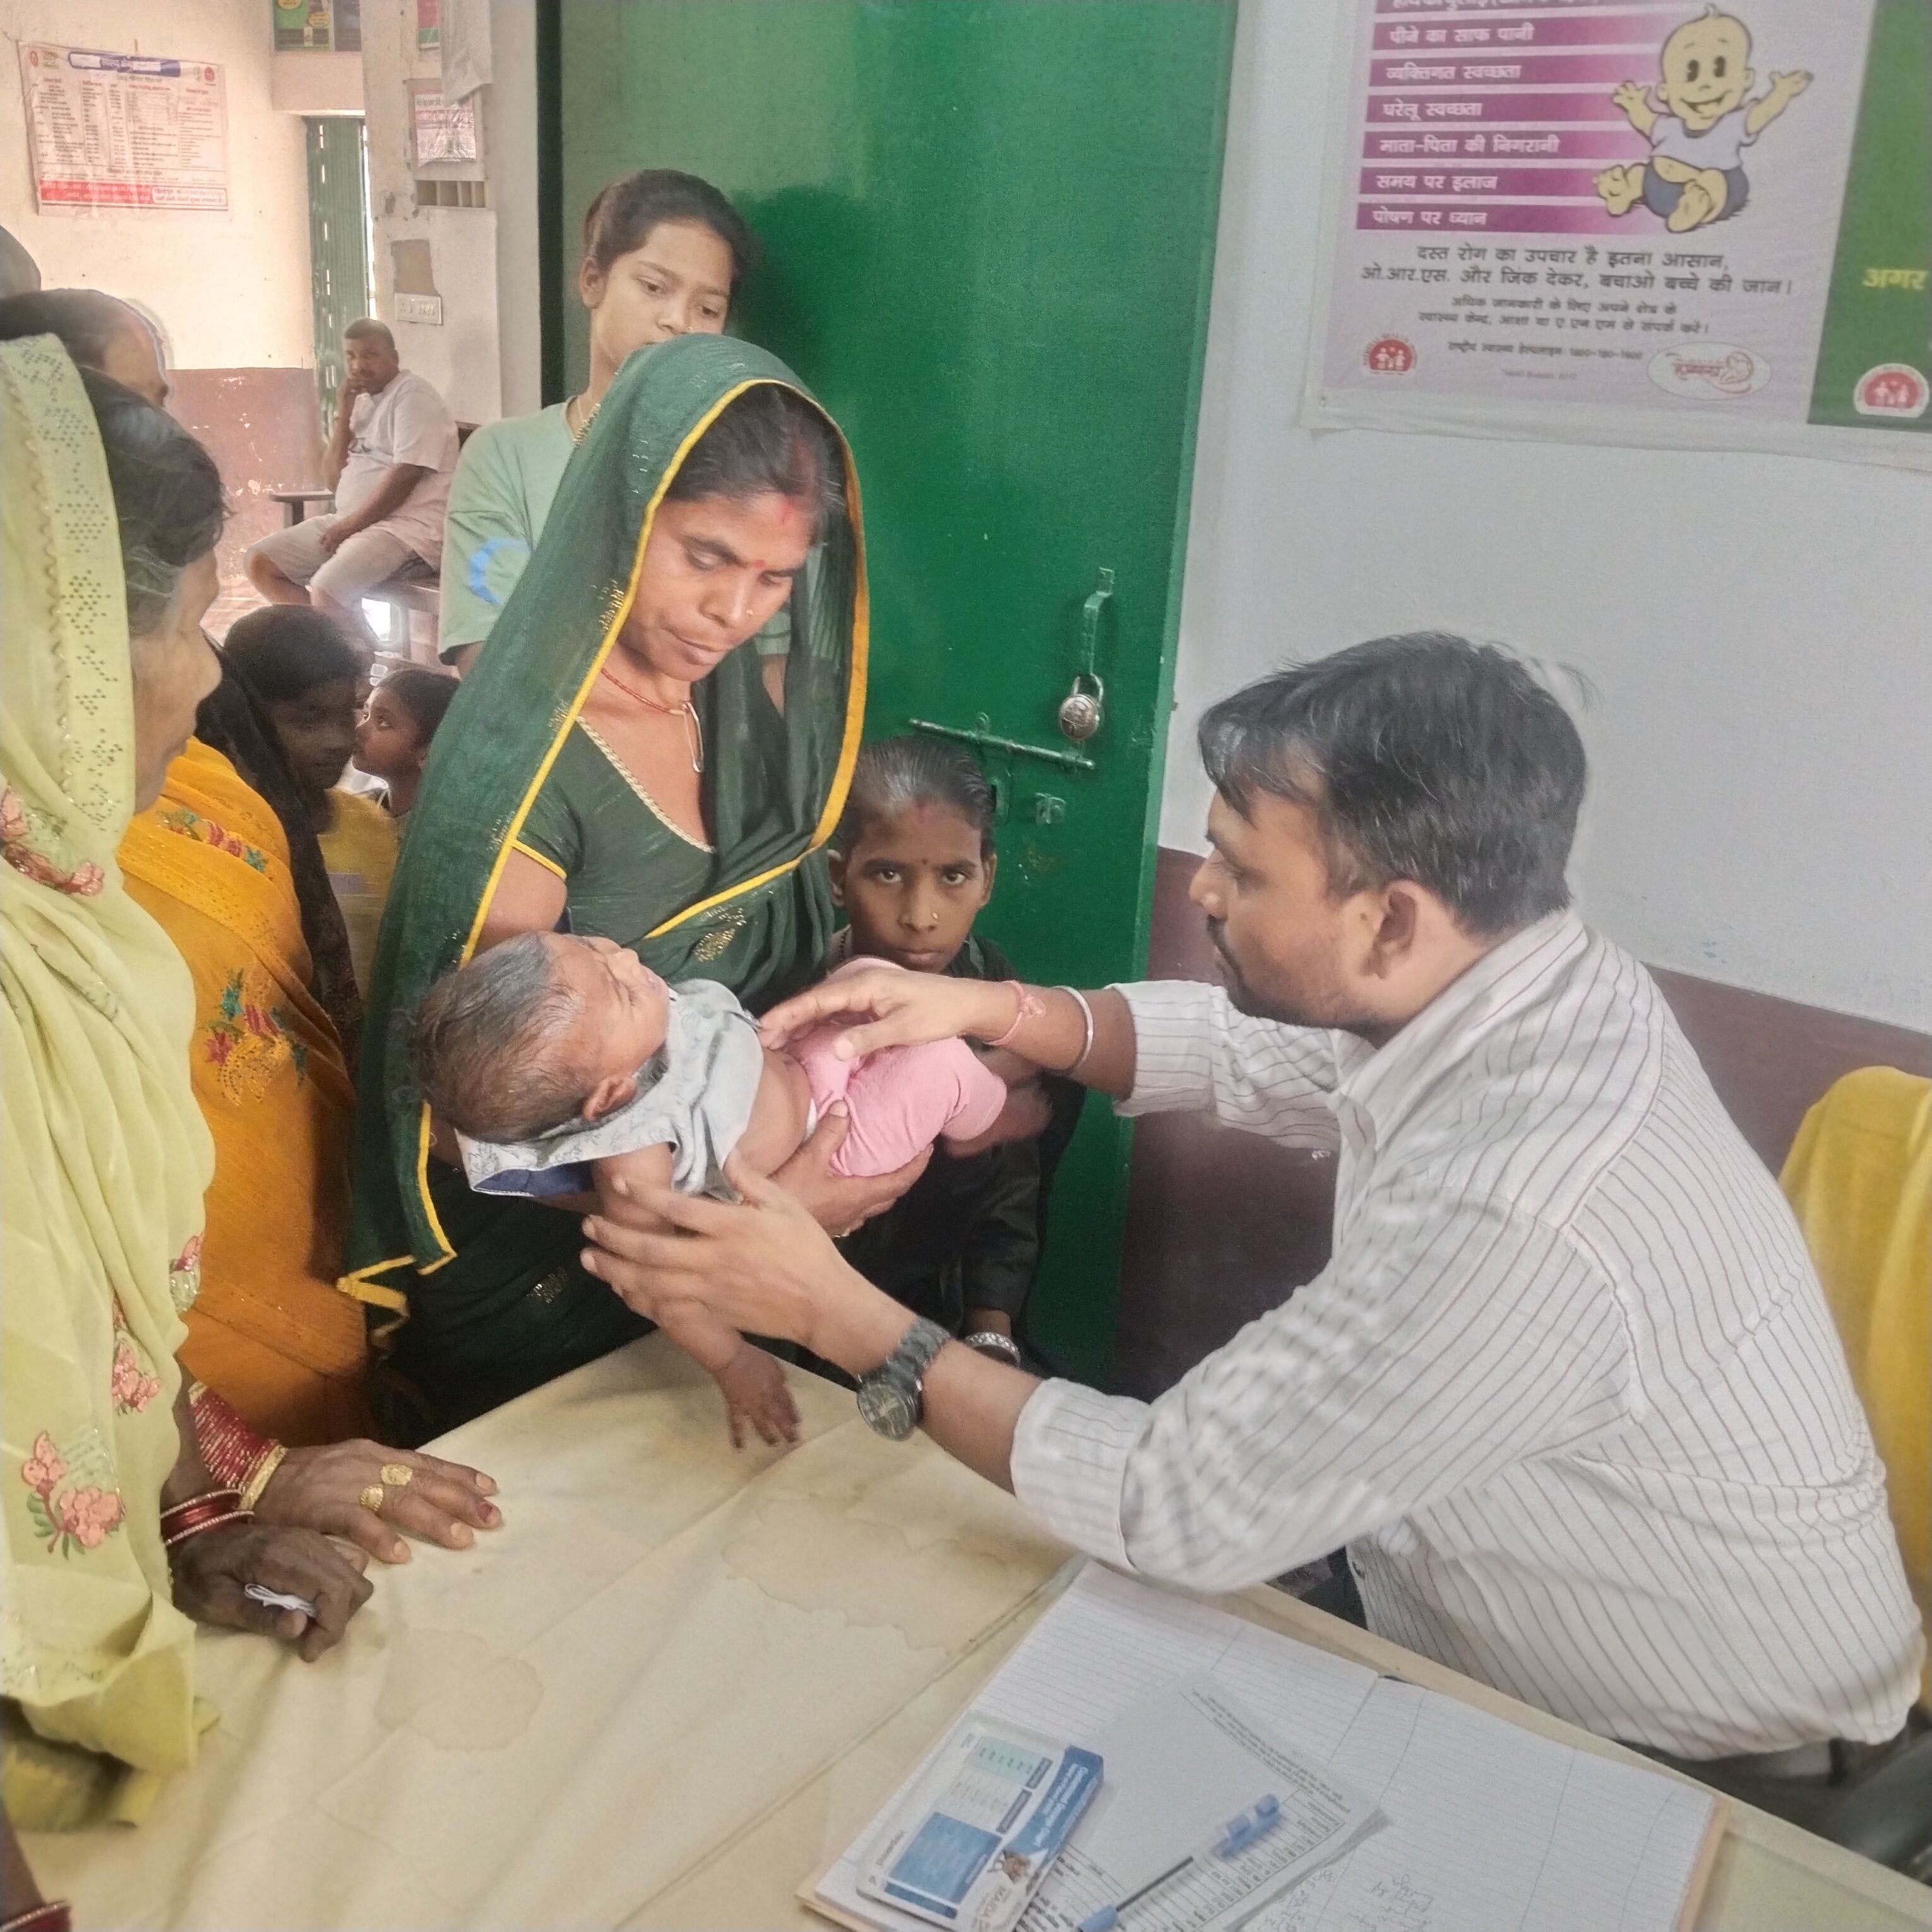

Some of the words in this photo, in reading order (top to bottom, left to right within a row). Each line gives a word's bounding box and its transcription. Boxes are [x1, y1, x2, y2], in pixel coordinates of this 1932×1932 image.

[1390, 25, 1419, 44] पीने
[1426, 28, 1446, 43] का
[1455, 27, 1490, 43] साफ
[1498, 22, 1534, 42] पानी
[1386, 62, 1455, 82] व्यक्तिगत
[1463, 64, 1522, 80] स्वच्छता
[1383, 98, 1421, 121] घरेलू
[1426, 102, 1482, 117] स्वच्छता
[1380, 134, 1457, 153] माता-पिता
[1464, 134, 1486, 153] की
[1493, 134, 1560, 153] निगरानी
[1376, 175, 1417, 189] समय
[1423, 176, 1445, 189] पर
[1452, 176, 1498, 192] इलाज
[1373, 206, 1414, 225] पोषण
[1421, 210, 1442, 225] पर
[1449, 210, 1488, 225] ध्यान
[1417, 246, 1450, 260] दस्त
[1458, 242, 1488, 261] रोग
[1495, 249, 1517, 262] का
[1524, 249, 1577, 263] उपचार
[1583, 244, 1599, 265] है
[1607, 251, 1653, 268] इतना
[1662, 253, 1728, 270] आसान,
[1460, 265, 1493, 283] और
[1546, 268, 1589, 289] देकर,
[1599, 270, 1655, 289] बचाओ
[1664, 271, 1700, 291] बच्चे
[1708, 273, 1732, 292] की
[1863, 268, 1929, 290] अगर
